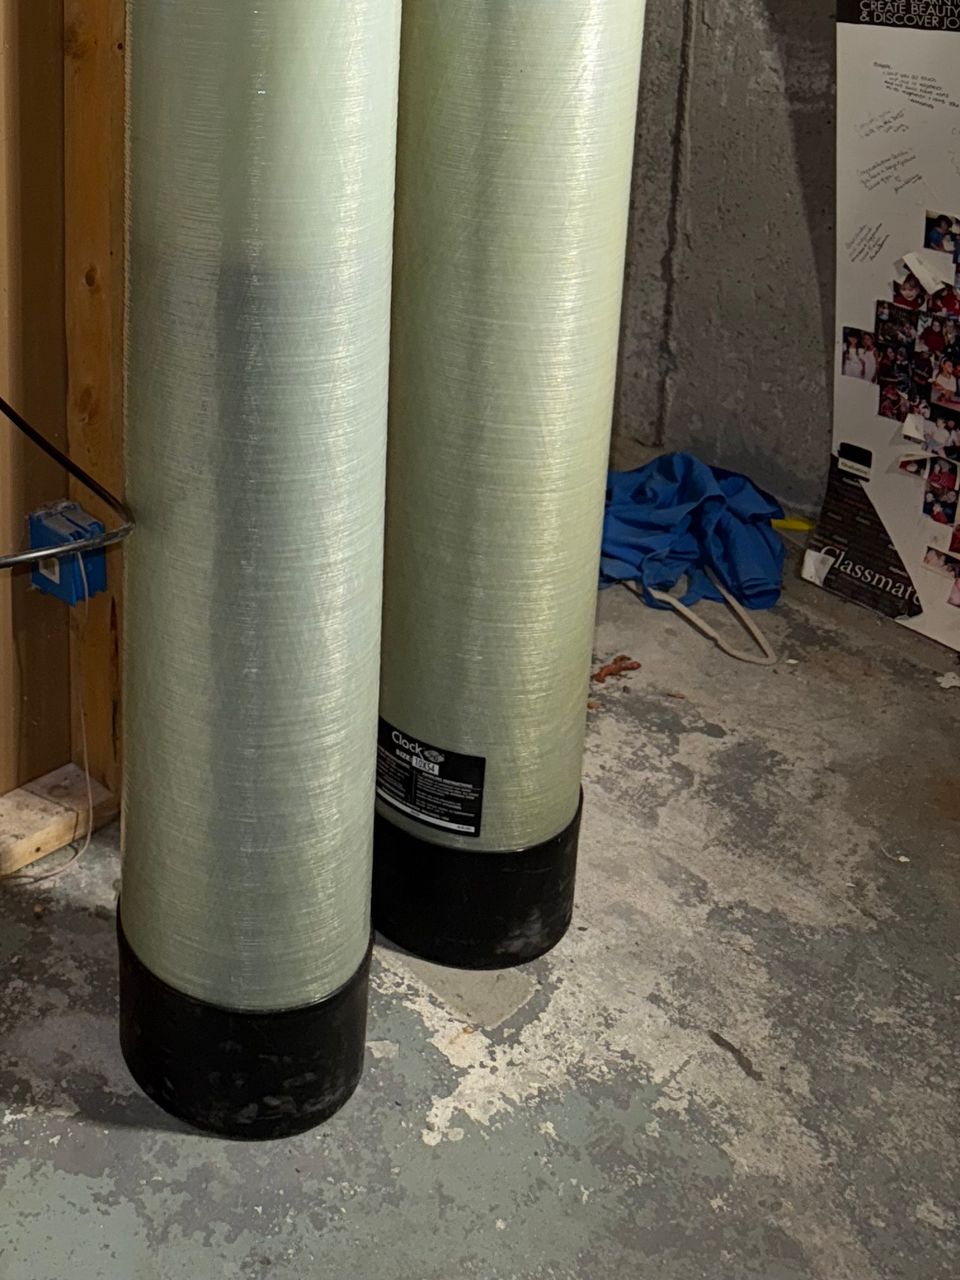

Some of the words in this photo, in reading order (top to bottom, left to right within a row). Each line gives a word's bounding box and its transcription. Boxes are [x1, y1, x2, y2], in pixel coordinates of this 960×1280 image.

[860, 0, 906, 14] CREATE
[911, 4, 960, 17] BEAUTY
[874, 12, 939, 27] DISCOVER
[392, 731, 423, 757] Clack
